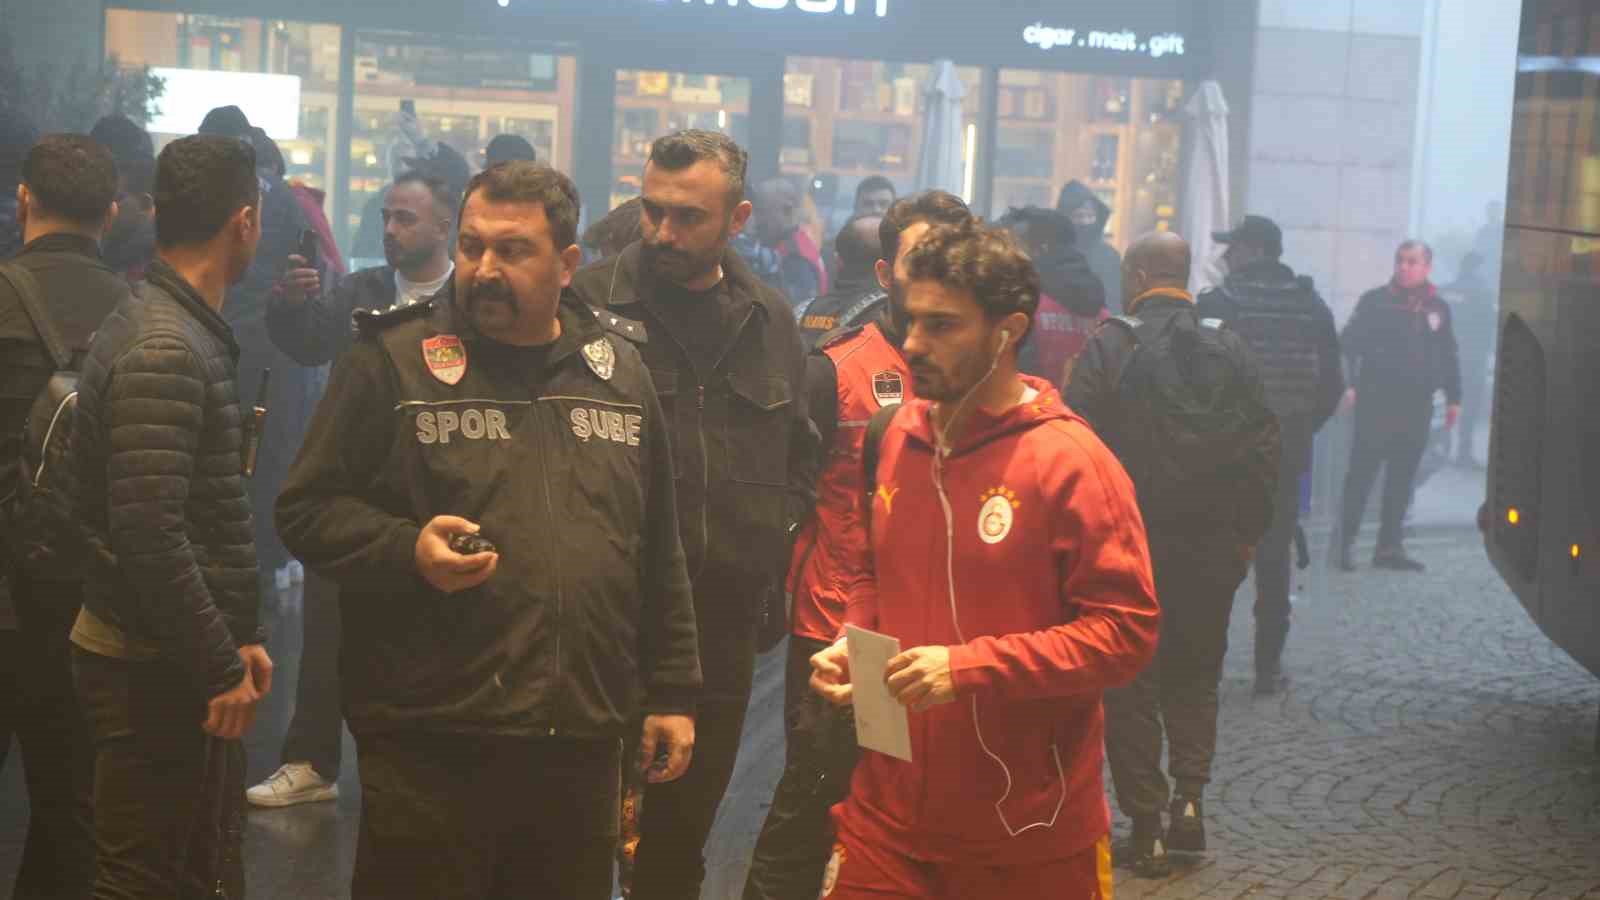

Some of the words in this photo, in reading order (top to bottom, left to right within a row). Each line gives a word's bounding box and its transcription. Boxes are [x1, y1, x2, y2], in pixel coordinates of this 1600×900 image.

[1023, 22, 1076, 49] cigar
[1149, 34, 1184, 56] gift
[416, 408, 511, 443] SPOR
